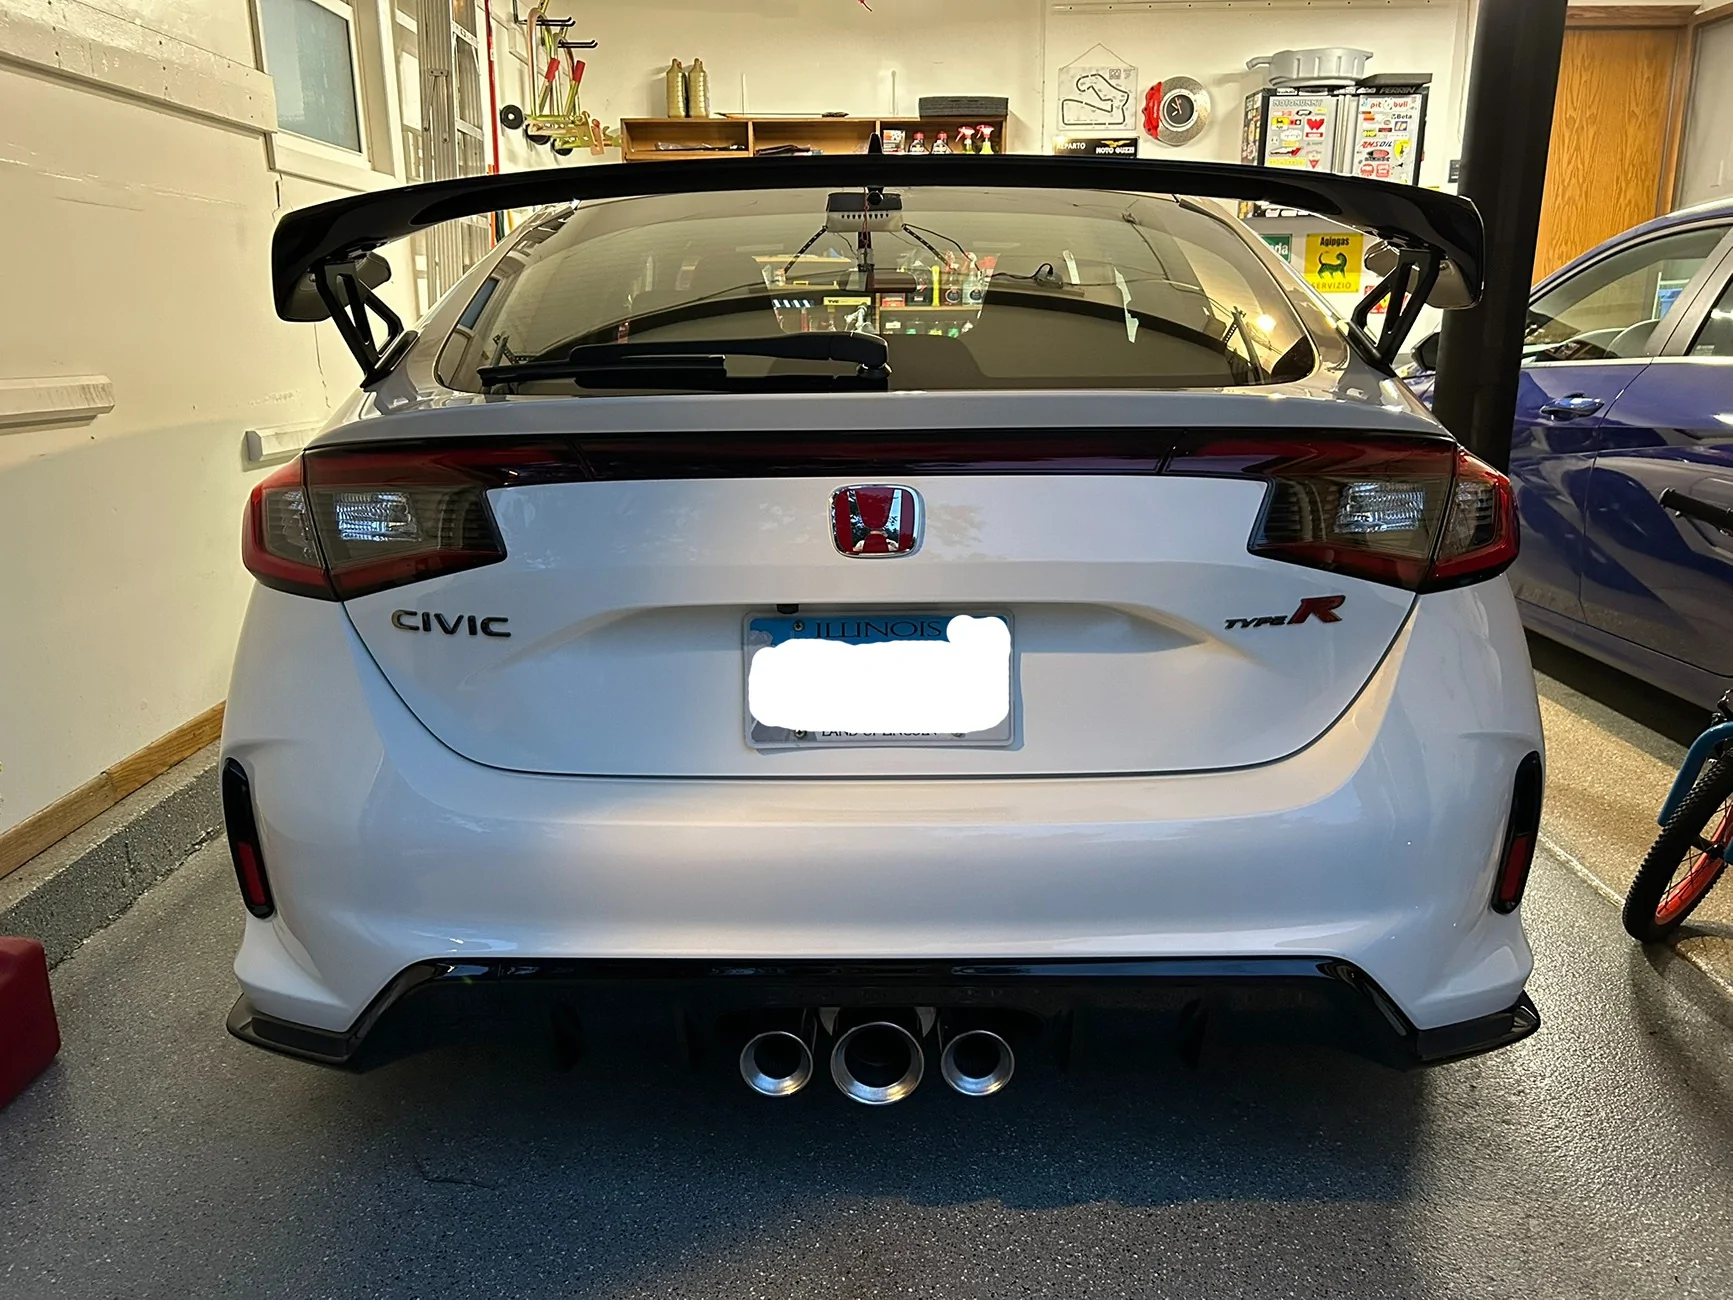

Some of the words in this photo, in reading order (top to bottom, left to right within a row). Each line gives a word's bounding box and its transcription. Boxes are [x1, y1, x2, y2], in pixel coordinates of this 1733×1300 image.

[1370, 101, 1382, 109] pit
[1319, 236, 1350, 247] Agipgas
[1311, 281, 1352, 290] SERVIZIO
[1224, 615, 1288, 630] TYPE
[1286, 594, 1347, 624] R
[391, 609, 511, 638] CIVIC
[816, 620, 942, 639] ILLINOIS
